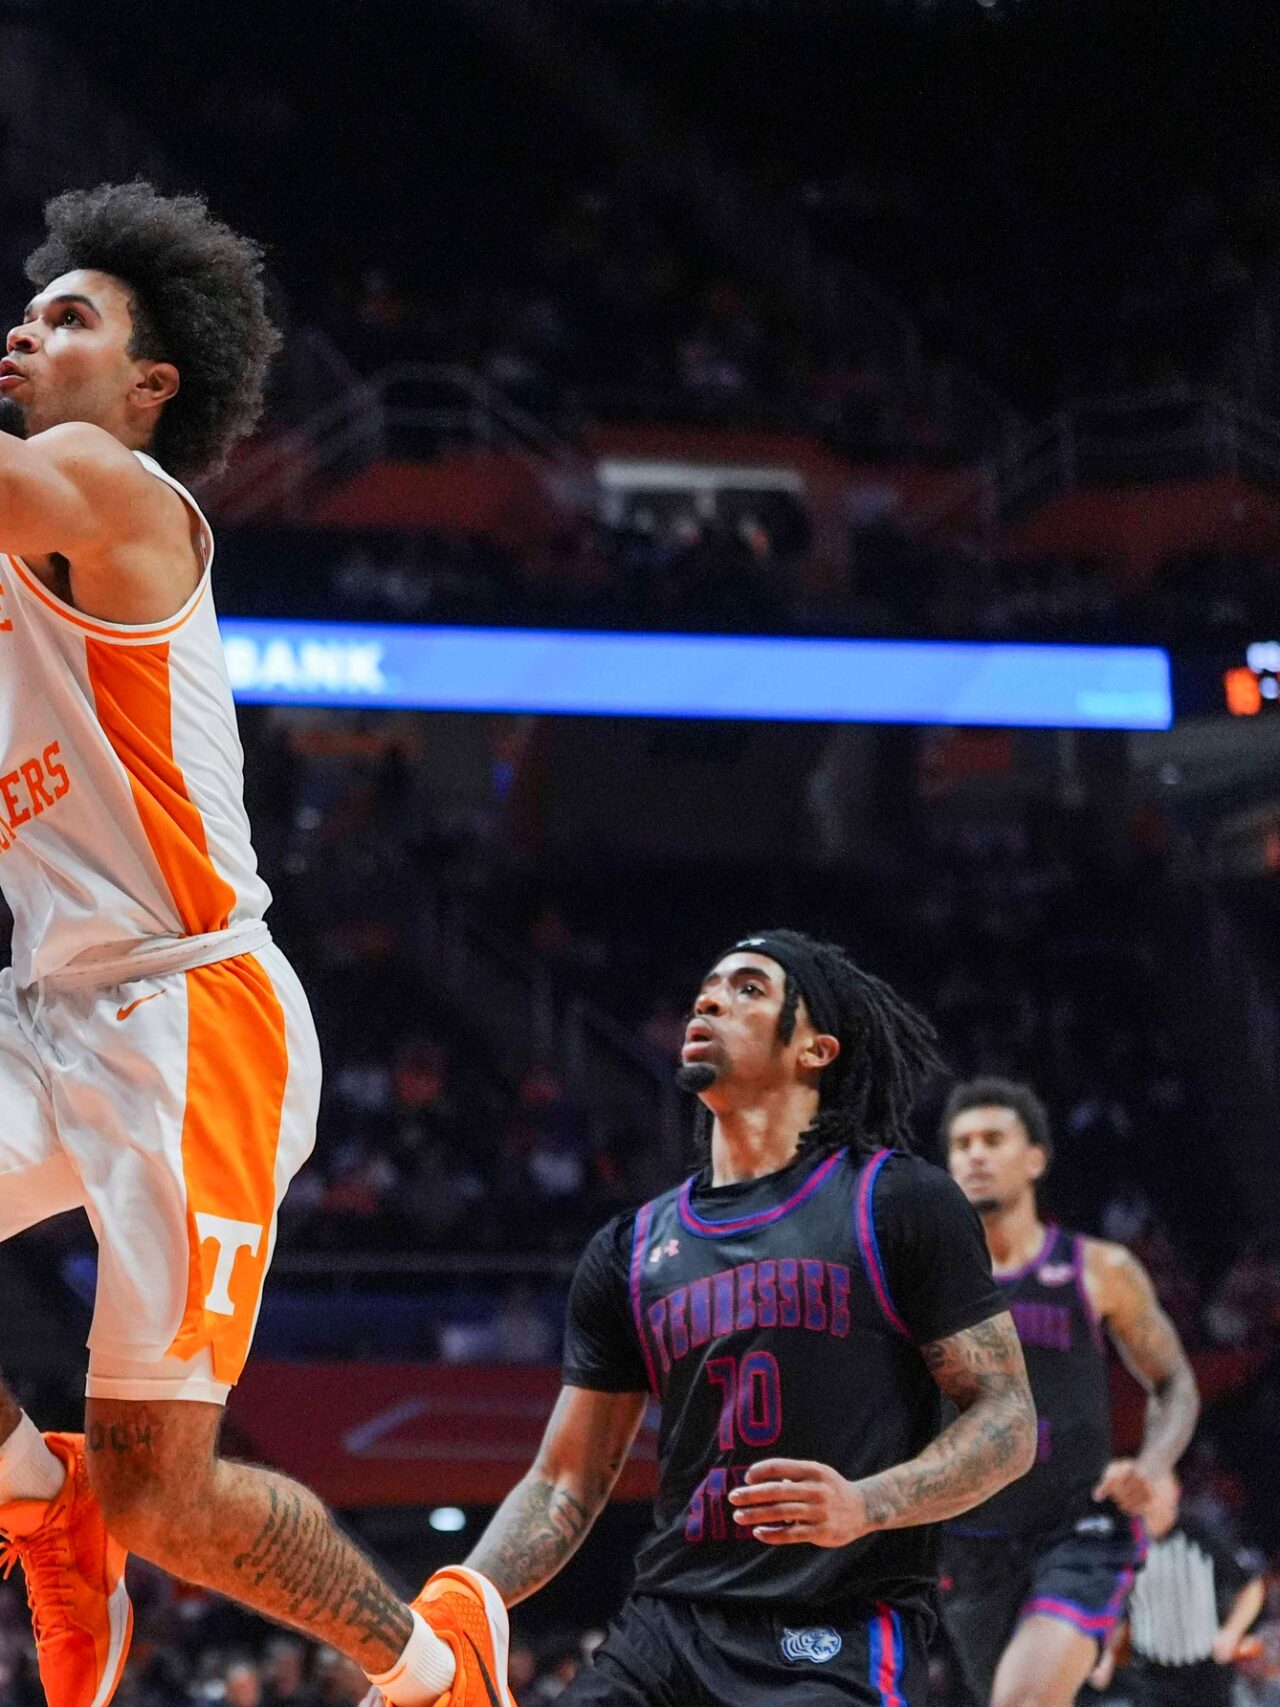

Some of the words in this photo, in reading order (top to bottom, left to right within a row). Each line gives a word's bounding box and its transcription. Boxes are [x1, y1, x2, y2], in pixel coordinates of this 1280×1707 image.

[223, 636, 386, 694] BANK
[194, 1211, 263, 1316] T
[647, 1258, 851, 1374] TENNESSEE
